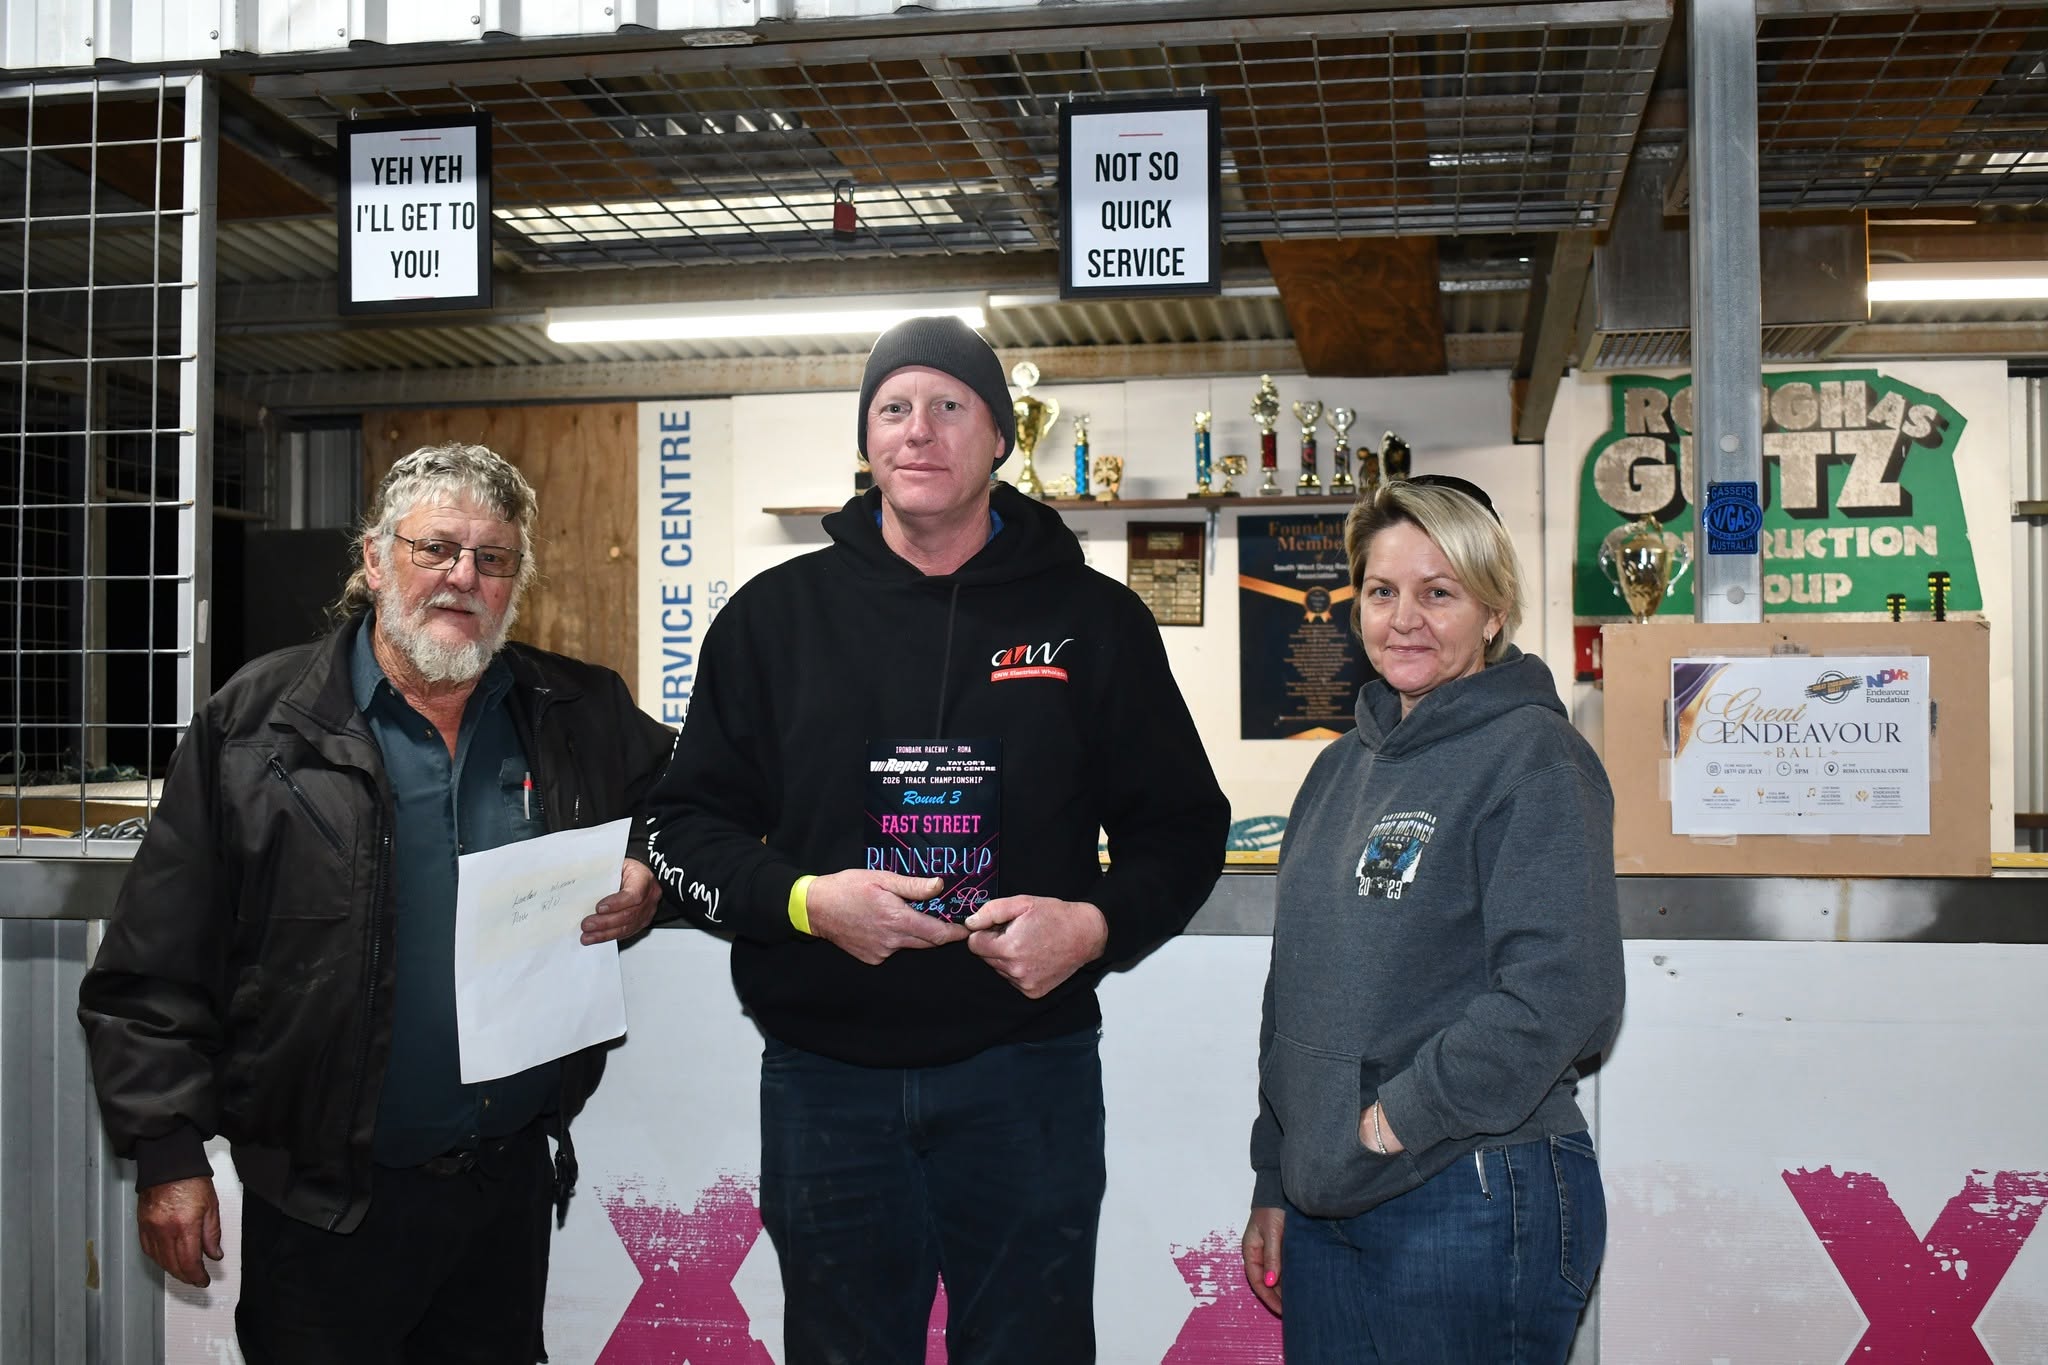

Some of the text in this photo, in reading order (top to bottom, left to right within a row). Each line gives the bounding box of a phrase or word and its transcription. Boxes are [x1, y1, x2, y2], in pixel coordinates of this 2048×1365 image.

[371, 155, 462, 185] YEH YEH
[1095, 151, 1178, 182] NOT SO
[357, 201, 475, 232] I'LL GET TO
[1101, 200, 1172, 231] QUICK
[390, 250, 439, 278] YOU!
[1088, 247, 1185, 278] SERVICE
[1624, 380, 1867, 434] RGH
[1594, 430, 1902, 514] GTZ
[660, 410, 692, 567] CENTRE
[1711, 486, 1753, 499] GASSERS
[1268, 521, 1344, 537] Foundat
[1278, 536, 1344, 551] Membe
[1711, 540, 1754, 551] AUSTRALIA
[708, 580, 728, 624] 55
[661, 583, 692, 724] ERVICE
[1703, 688, 1807, 735] Great
[1723, 722, 1902, 744] ENDEAVOUR
[884, 758, 929, 774] Repco
[1776, 747, 1826, 758] BALL
[902, 790, 962, 805] Round 3
[882, 815, 981, 833] FAST STREET
[866, 847, 992, 875] RUNNER UP
[689, 881, 722, 922] The
[1358, 877, 1403, 899] 20 23
[929, 897, 945, 913] By
